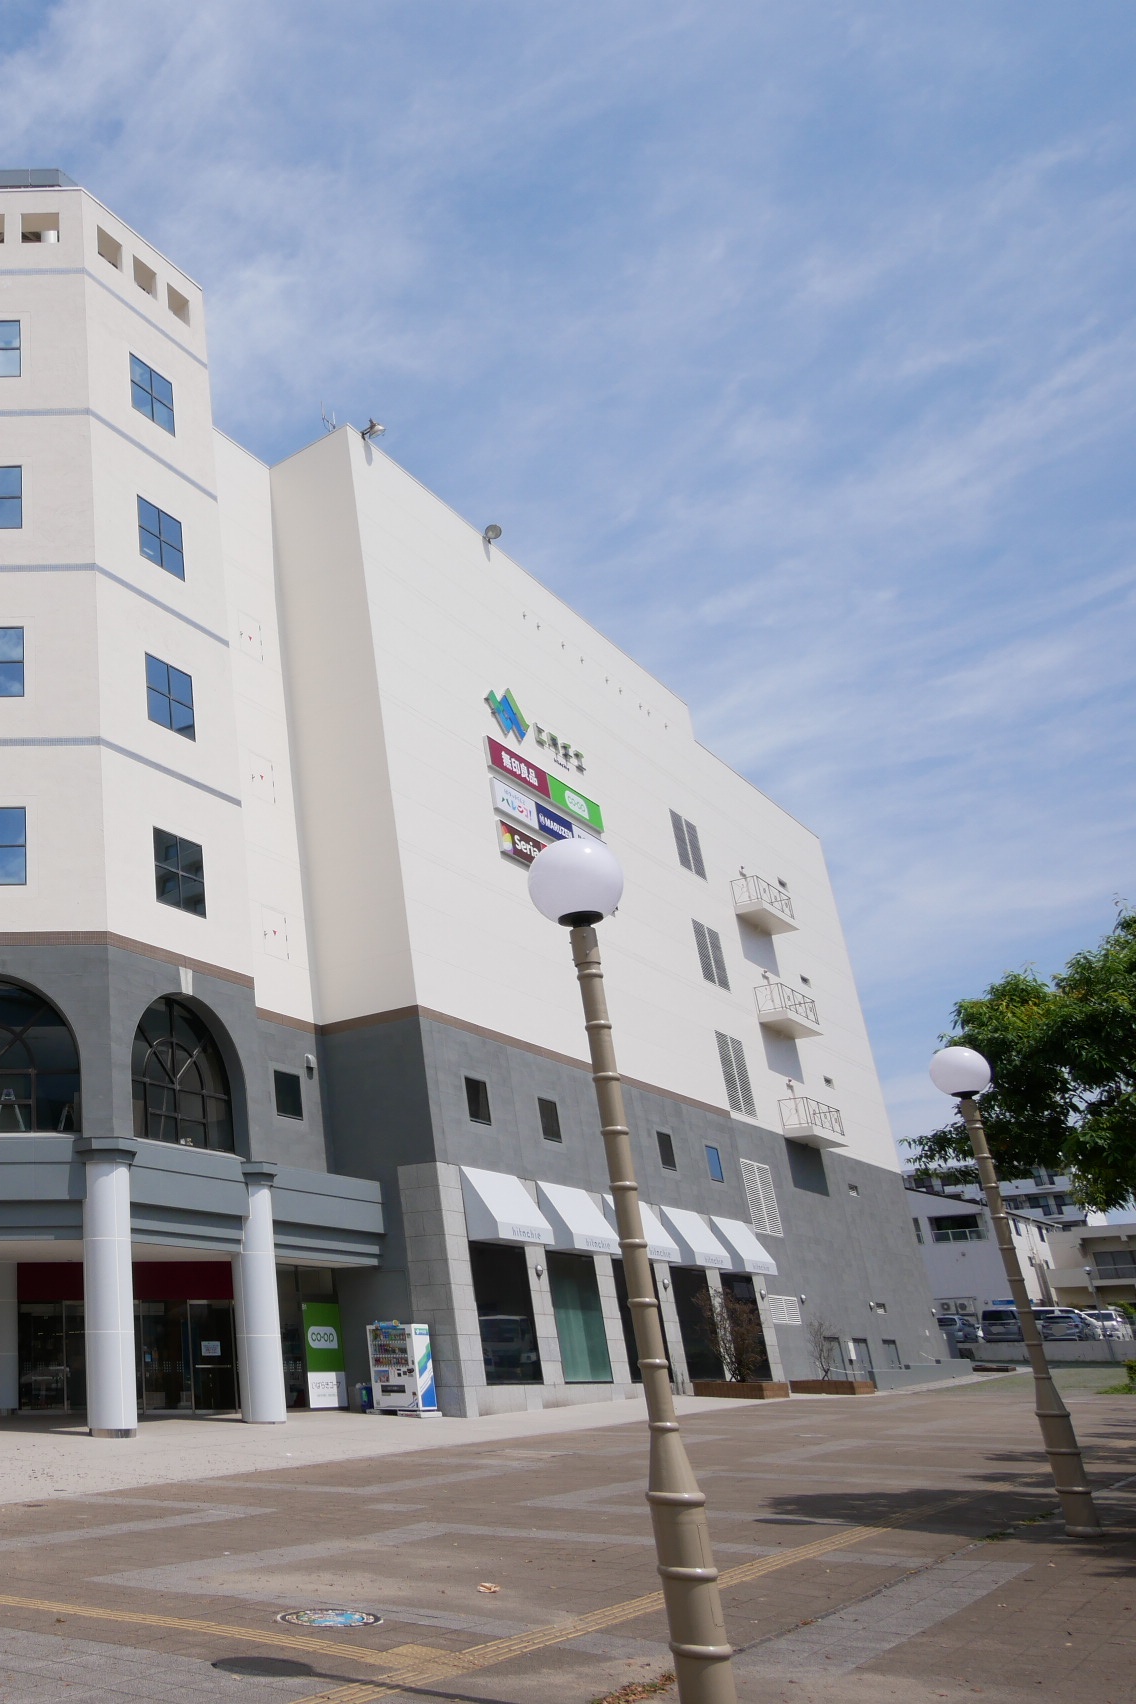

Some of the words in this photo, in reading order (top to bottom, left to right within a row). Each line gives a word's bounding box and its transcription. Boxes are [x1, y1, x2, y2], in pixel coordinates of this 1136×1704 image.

[501, 751, 539, 787] 無印良品
[514, 834, 540, 858] Seria
